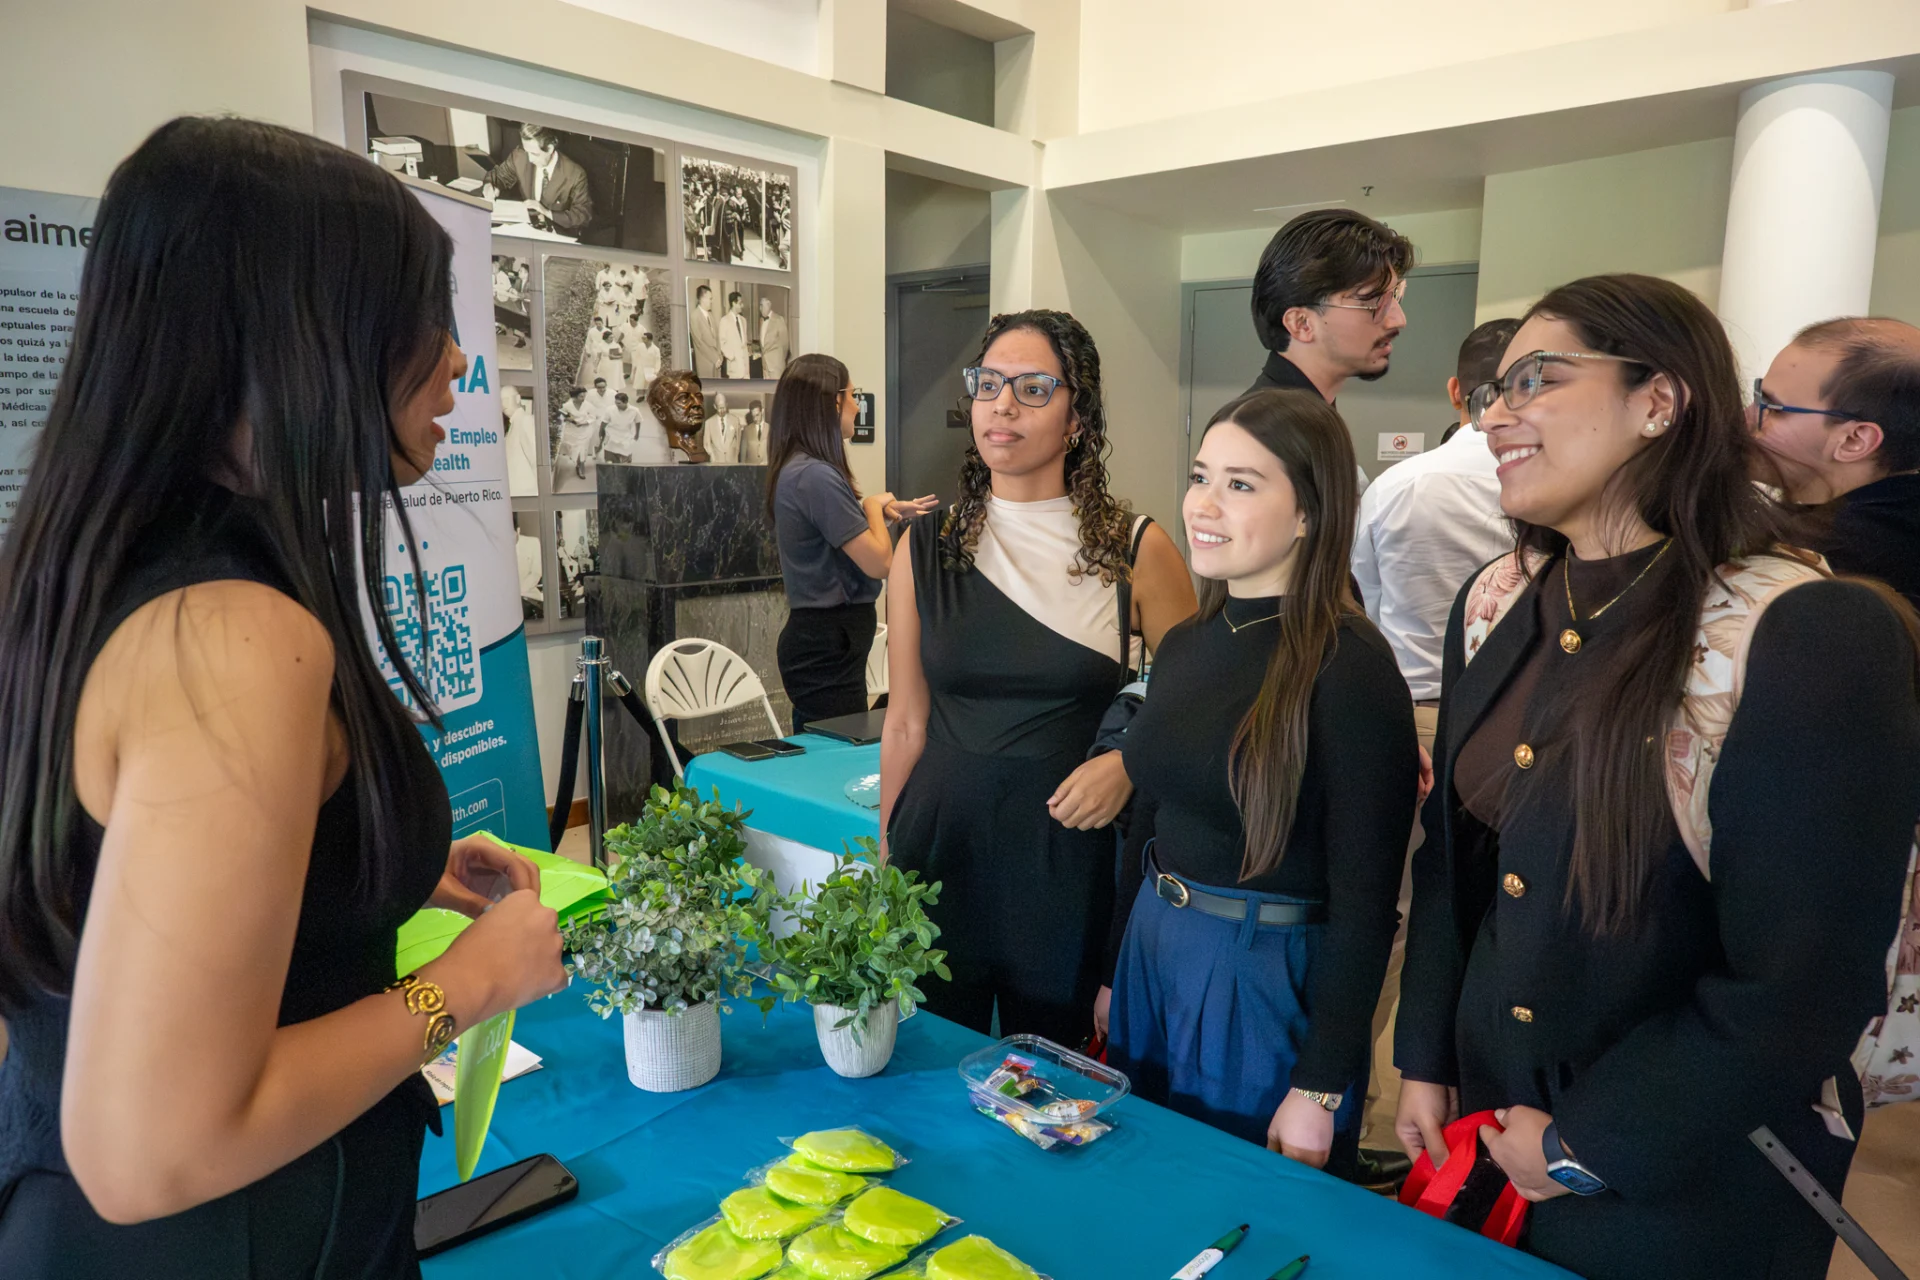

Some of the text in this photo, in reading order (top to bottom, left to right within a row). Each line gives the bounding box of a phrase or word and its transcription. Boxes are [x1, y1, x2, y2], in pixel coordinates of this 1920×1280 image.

[0, 214, 93, 249] aime
[41, 290, 53, 298] de
[57, 291, 66, 299] la
[19, 306, 59, 315] escuela
[63, 308, 76, 316] de
[0, 321, 46, 331] eptuales
[17, 338, 45, 347] quizá
[49, 340, 61, 349] ya
[4, 353, 13, 361] la
[17, 354, 39, 362] idea
[43, 355, 55, 363] de
[32, 371, 45, 379] de
[16, 388, 33, 396] por
[2, 402, 47, 411] Médicas
[12, 419, 26, 427] así
[450, 427, 498, 447] Empleo
[431, 453, 471, 471] ealth
[403, 493, 427, 508] alud
[430, 492, 442, 505] de
[445, 490, 480, 504] Puerto
[482, 488, 503, 501] Rico.
[432, 738, 441, 752] y
[444, 719, 495, 746] descubre
[441, 735, 508, 768] disponibles.
